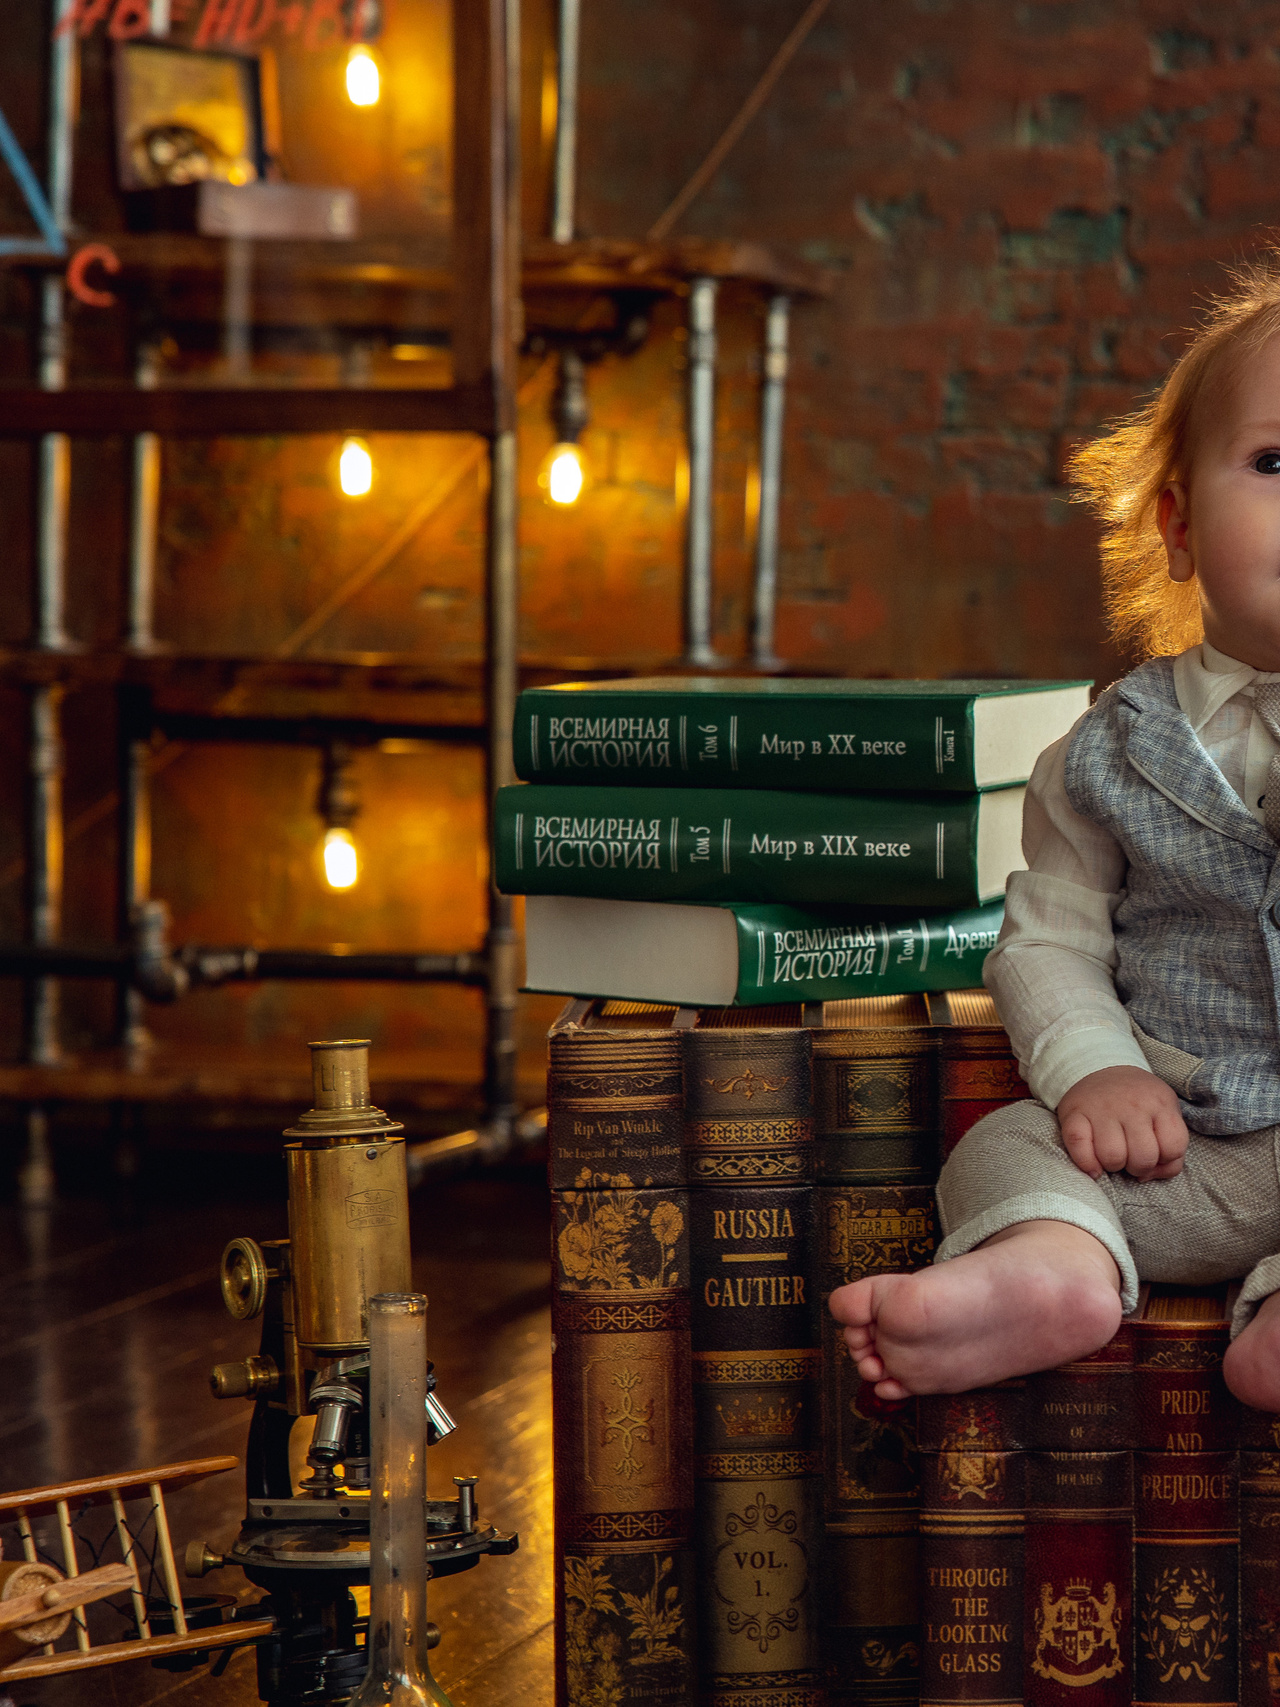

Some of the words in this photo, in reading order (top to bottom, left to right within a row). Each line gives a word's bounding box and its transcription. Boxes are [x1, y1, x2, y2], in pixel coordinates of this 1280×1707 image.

[549, 717, 671, 739] ВСЕМИРНАЯ
[698, 724, 718, 733] 6
[550, 740, 672, 767] ИСТОРИЯ
[700, 735, 718, 761] Том
[760, 734, 805, 761] Мир
[812, 741, 822, 755] в
[828, 734, 856, 755] XX
[862, 741, 907, 756] веке
[534, 816, 661, 840] ВСЕМИРНАЯ
[690, 825, 711, 834] 5
[535, 839, 661, 869] ИСТОРИЯ
[690, 837, 710, 862] Том
[750, 833, 797, 861] Мир
[804, 841, 814, 855] в
[821, 835, 859, 856] XIX
[864, 842, 911, 857] веке
[774, 924, 877, 954] ВСЕМИРНАЯ
[897, 939, 915, 964] Том
[773, 948, 876, 983] ИСТОРИЯ
[573, 1121, 594, 1139] Rip
[597, 1120, 619, 1135] Van
[713, 1208, 795, 1239] RUSSIA
[900, 1220, 923, 1234] POE
[704, 1275, 806, 1307] GAUTIER
[1042, 1402, 1119, 1415] ADVENTURES
[1161, 1390, 1211, 1415] PRIDE
[1070, 1426, 1084, 1438] OF
[1164, 1433, 1203, 1456] AND
[1142, 1474, 1231, 1505] PREJUDICE
[733, 1551, 788, 1570] VOL.
[754, 1580, 770, 1597] 1.
[951, 1597, 989, 1617] THE
[939, 1652, 1002, 1674] GLASS
[630, 1684, 686, 1697] Illustrated
